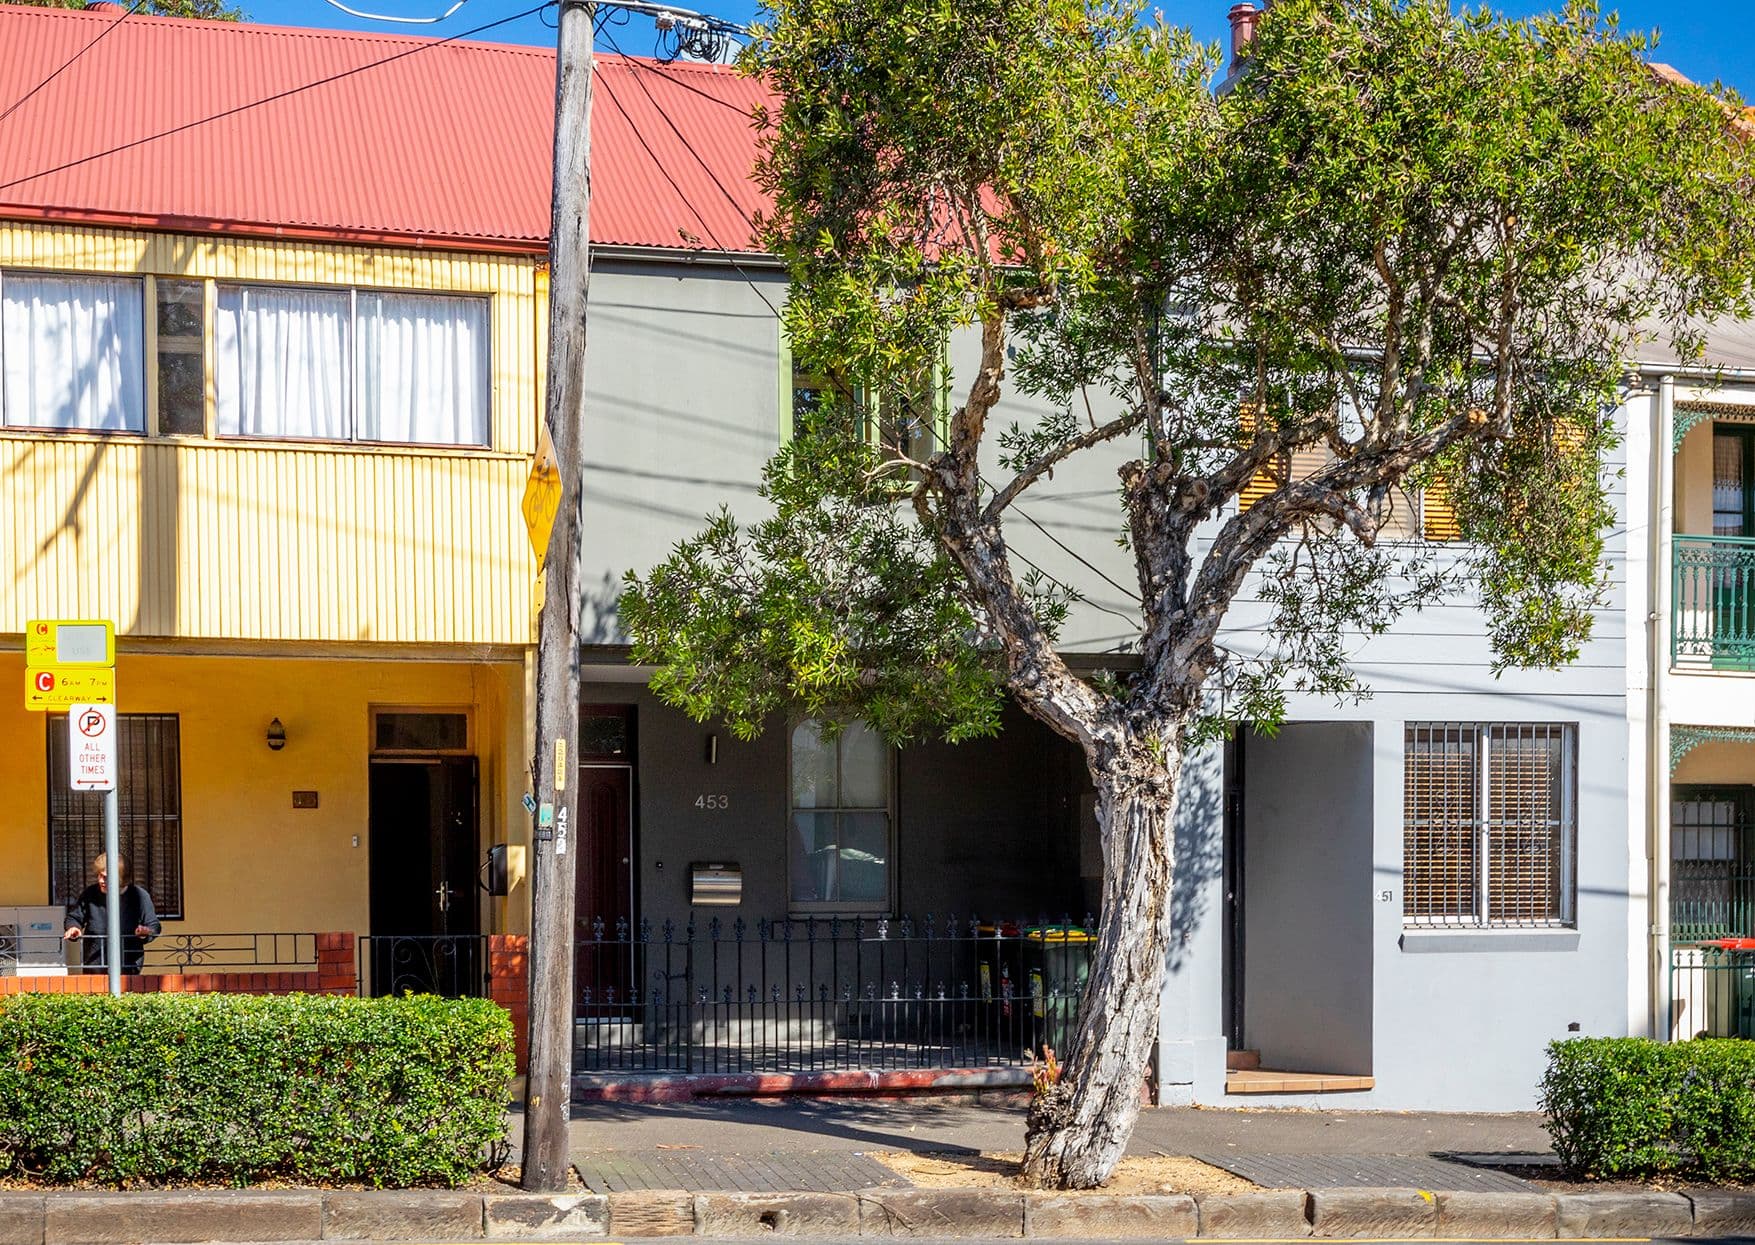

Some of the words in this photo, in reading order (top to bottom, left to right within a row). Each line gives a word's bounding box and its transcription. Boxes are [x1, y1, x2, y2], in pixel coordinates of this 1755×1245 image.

[84, 743, 100, 751] ALL
[79, 753, 106, 763] OTHER
[81, 765, 105, 775] TIMES
[694, 794, 729, 809] 453
